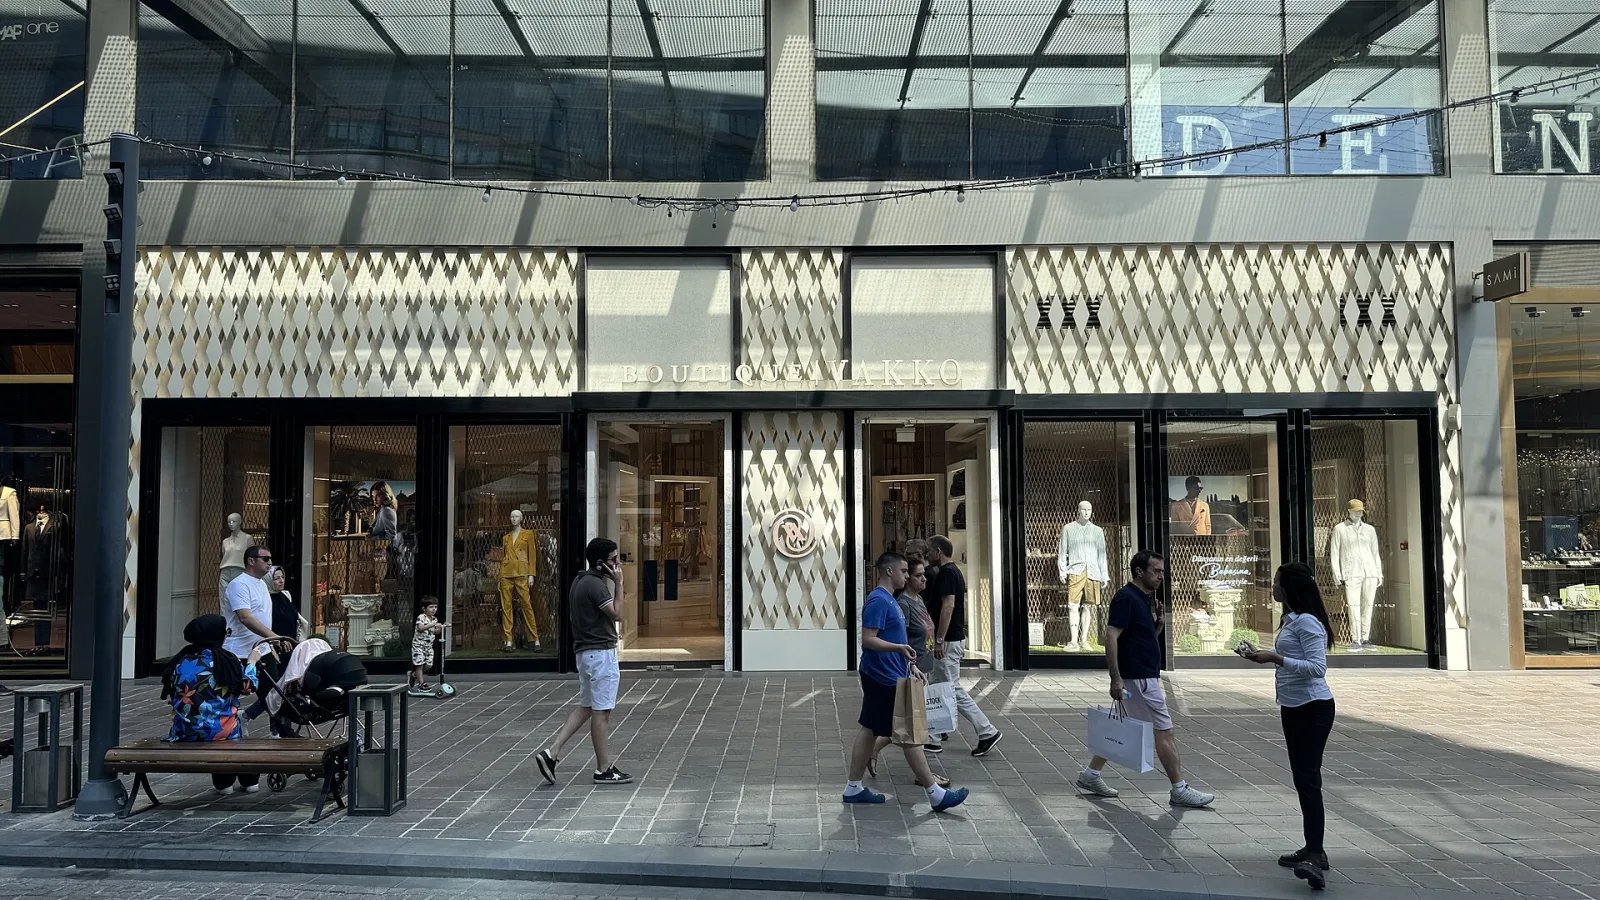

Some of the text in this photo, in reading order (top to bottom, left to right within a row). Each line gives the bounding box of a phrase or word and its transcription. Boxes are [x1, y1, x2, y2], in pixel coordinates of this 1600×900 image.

[26, 21, 59, 35] one
[621, 358, 962, 389] BOUTIQUE VAKKO
